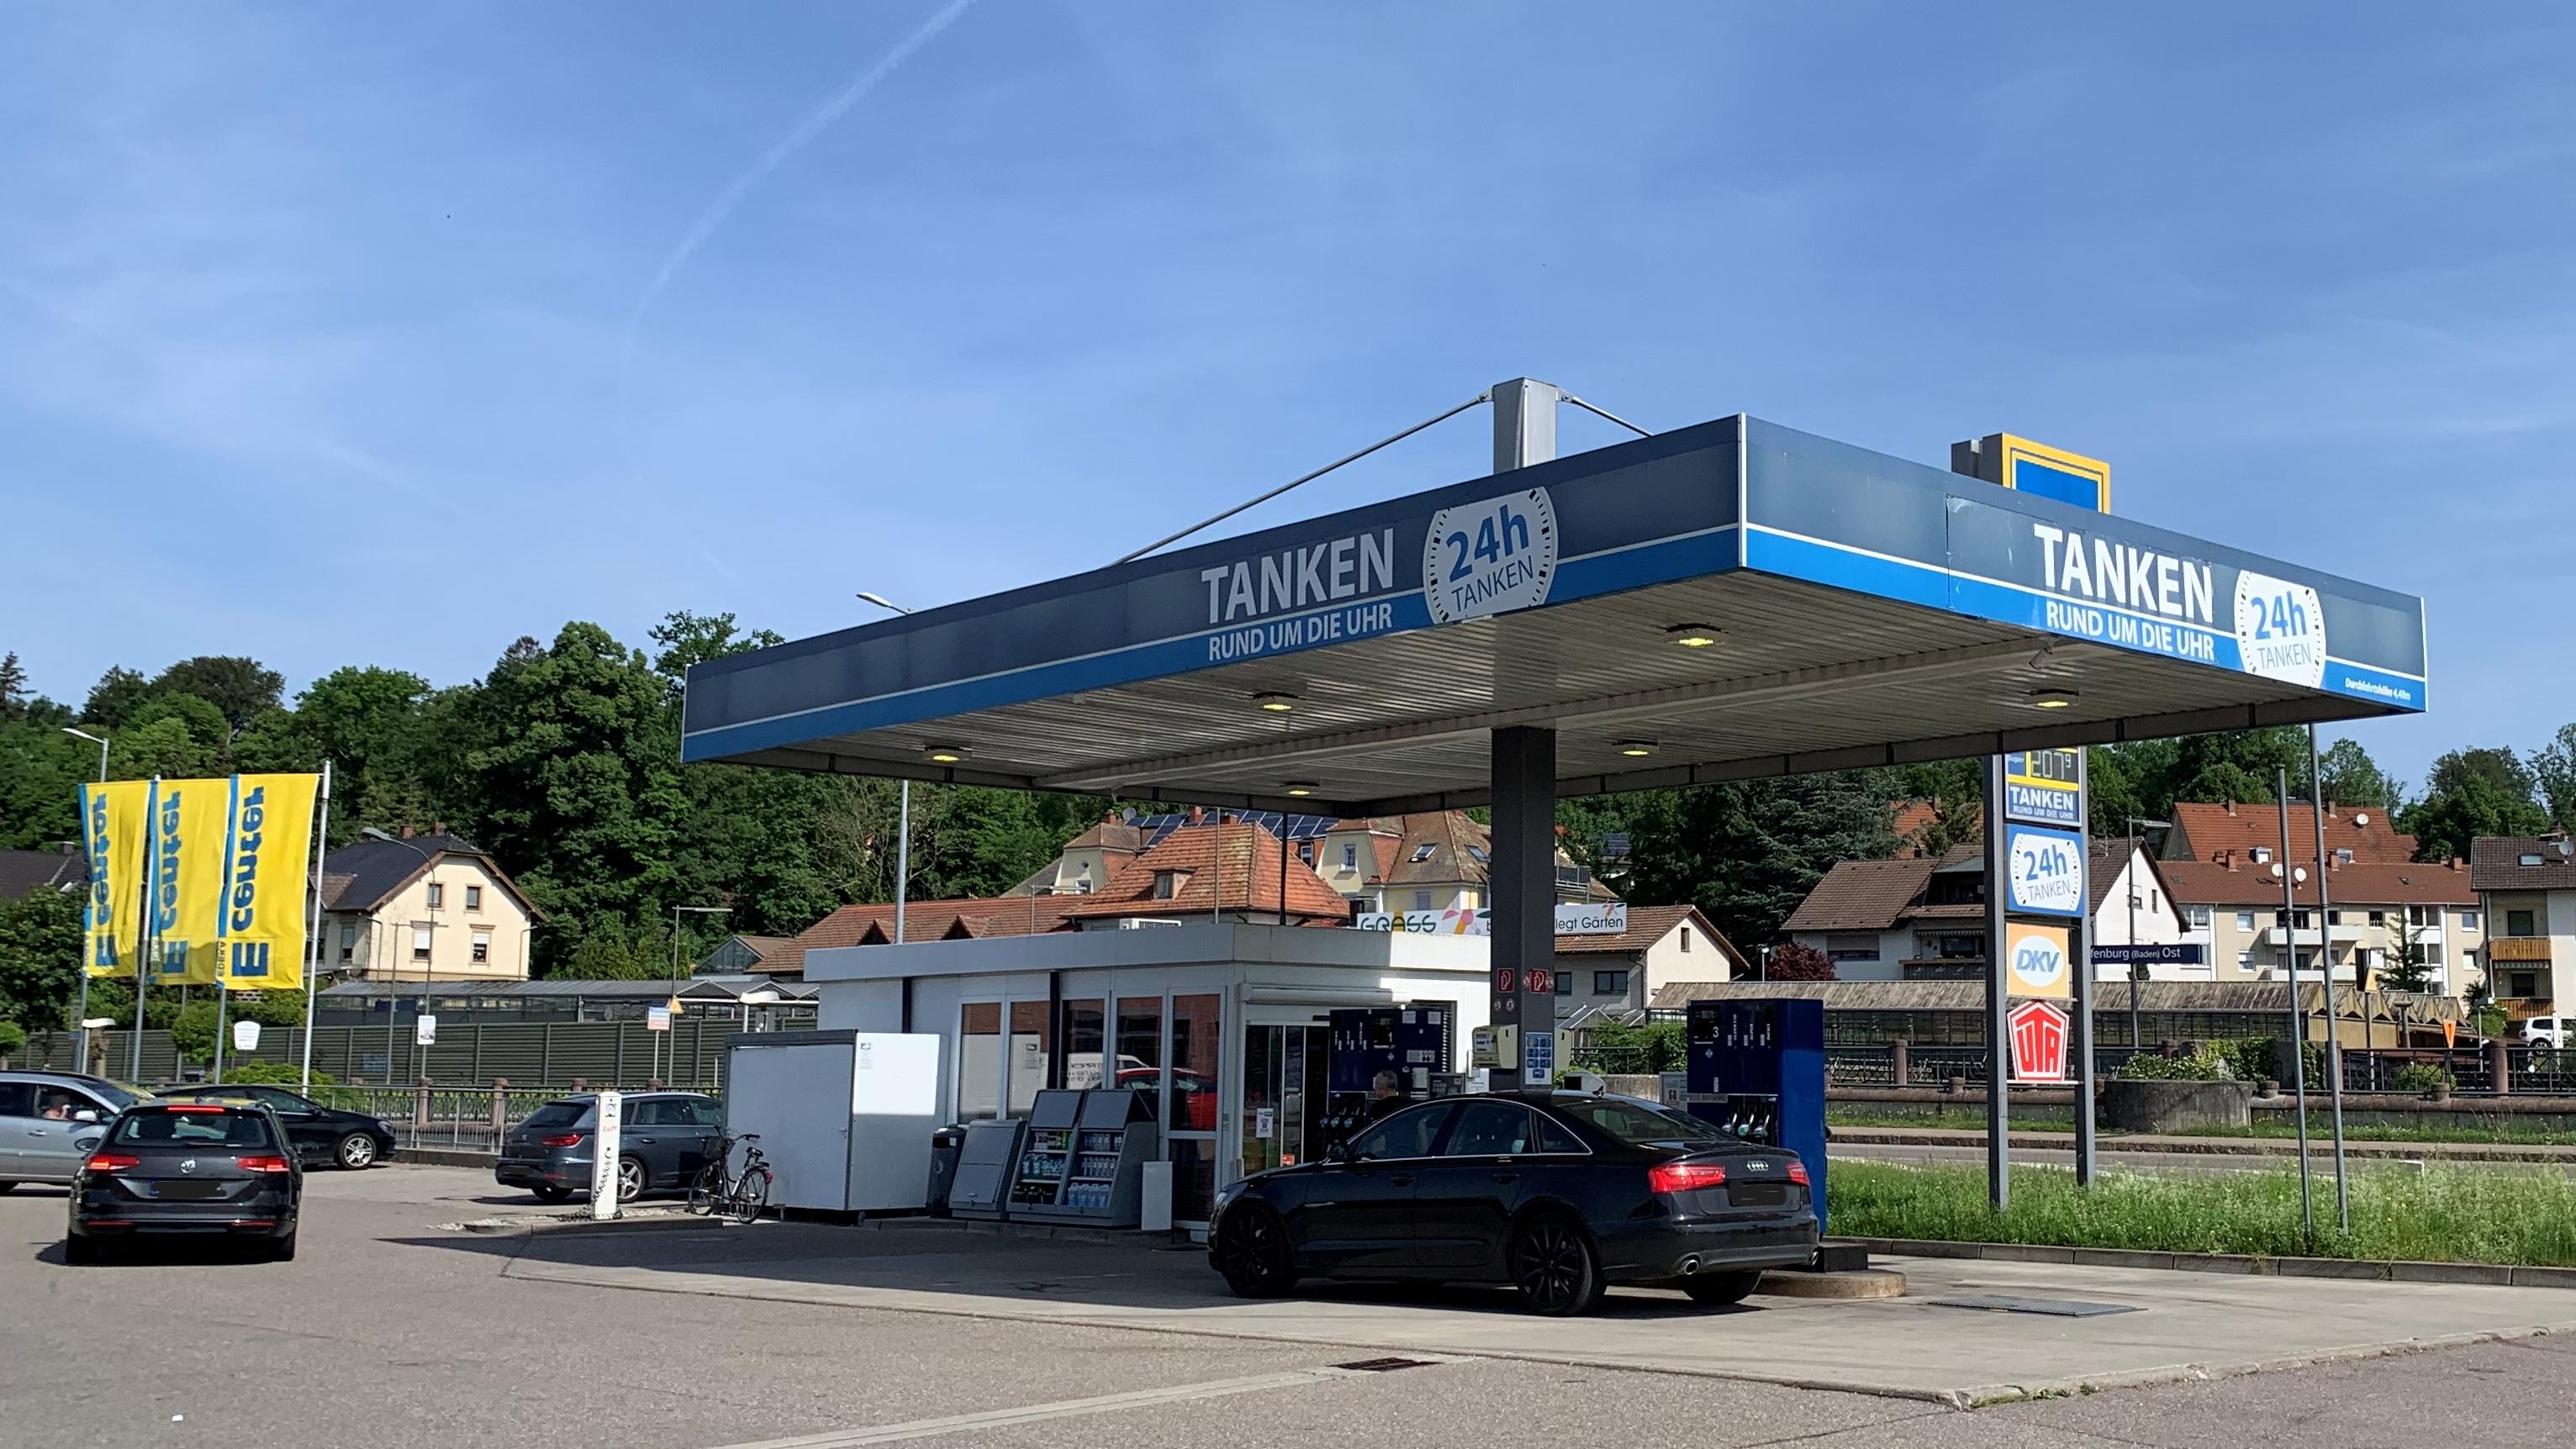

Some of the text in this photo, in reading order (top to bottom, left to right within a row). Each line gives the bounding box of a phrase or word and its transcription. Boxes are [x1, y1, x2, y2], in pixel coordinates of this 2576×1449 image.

[1446, 504, 1529, 582] 24h
[1201, 528, 1393, 624] TANKEN
[1451, 555, 1533, 612] TANKEN
[2034, 523, 2213, 623] TANKEN
[2046, 601, 2214, 661] RUND UM DIE UHR
[2251, 591, 2307, 640] 24h
[1209, 603, 1392, 661] RUND UM DIE UHR
[2257, 643, 2312, 670] TANKEN
[2010, 786, 2073, 811] TANKEN
[2014, 804, 2073, 819] RUND UM DIE UHR
[2024, 844, 2067, 881] 24h
[2027, 879, 2071, 901] TANKEN
[1361, 914, 1436, 933] GRASS
[1581, 916, 1623, 928] Gärten
[2015, 949, 2060, 972] DKV
[2131, 950, 2160, 960] (Baden)
[2162, 946, 2181, 958] Ost
[1388, 1031, 1392, 1042] 1
[1713, 1026, 1719, 1038] 3
[2015, 1007, 2061, 1072] UTA
